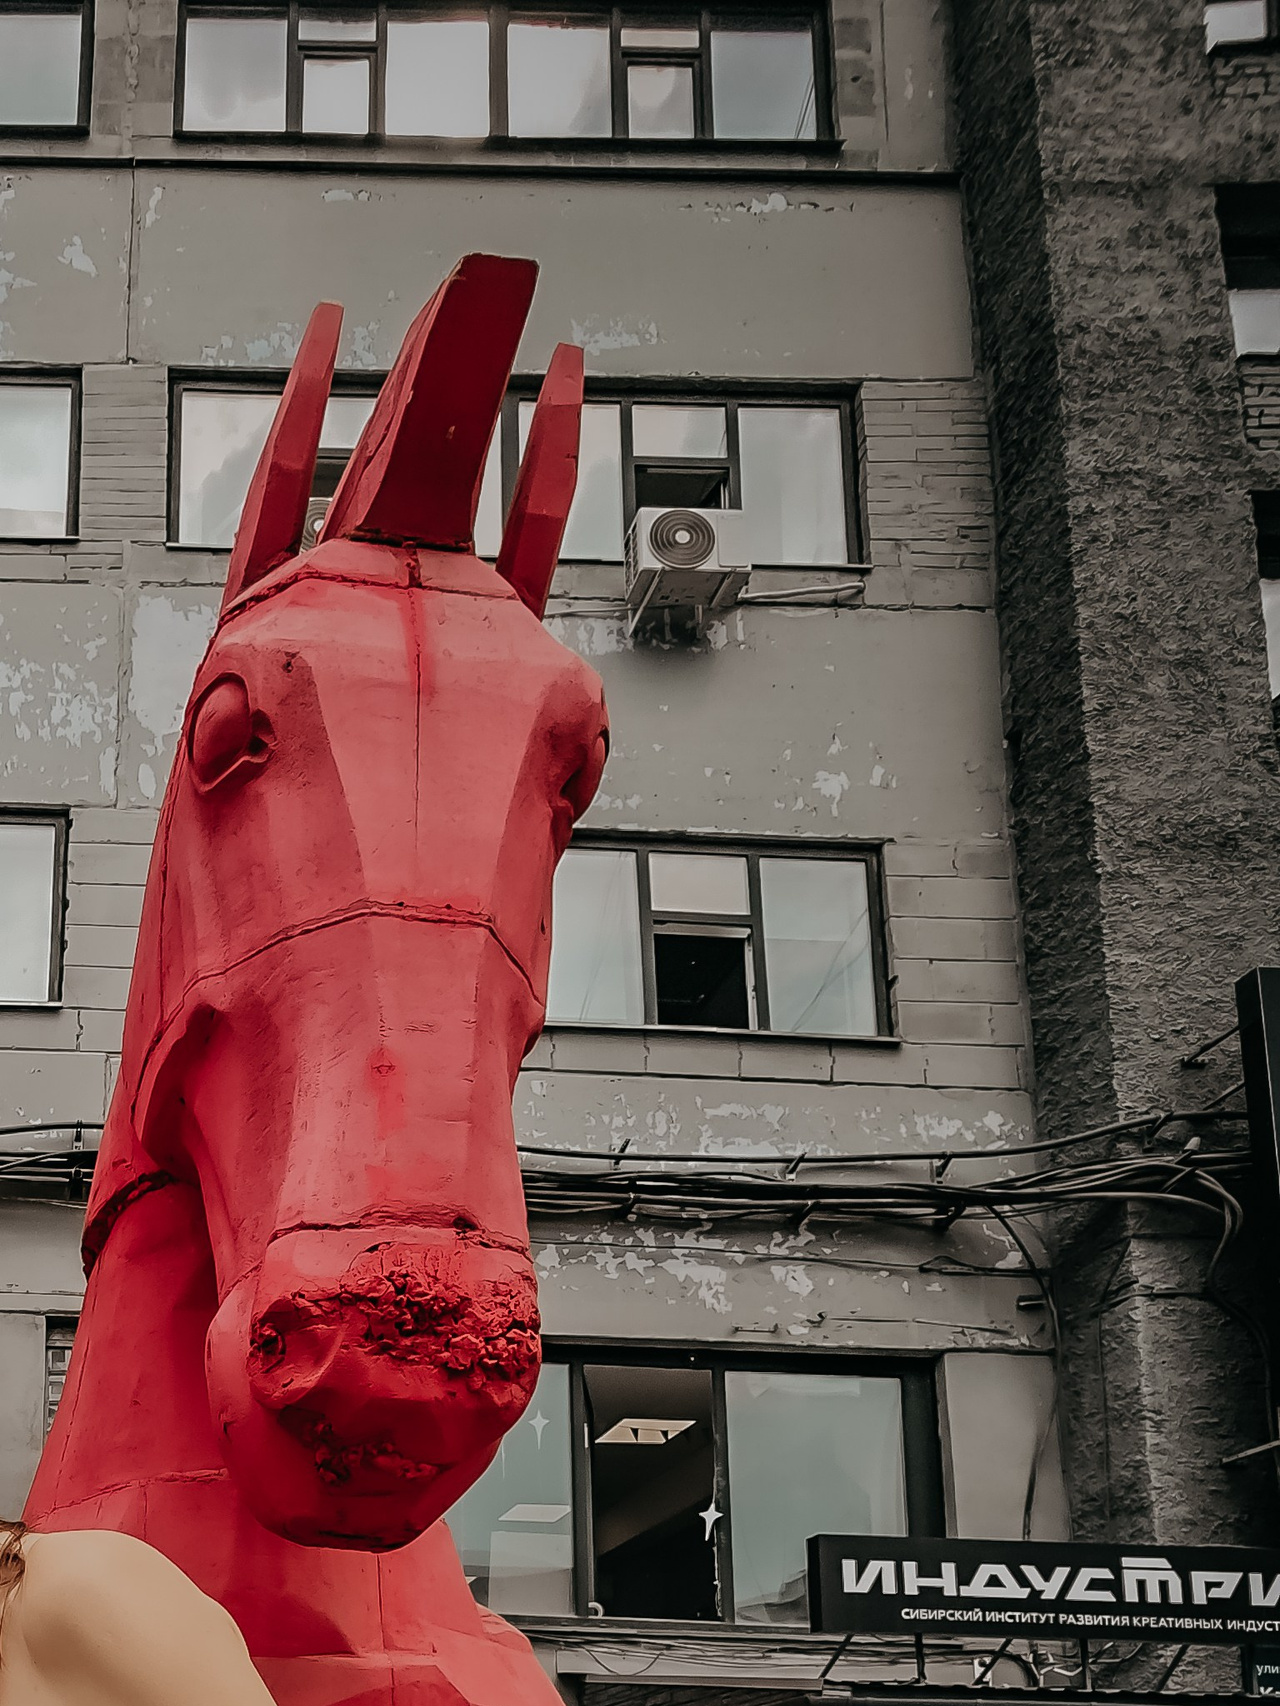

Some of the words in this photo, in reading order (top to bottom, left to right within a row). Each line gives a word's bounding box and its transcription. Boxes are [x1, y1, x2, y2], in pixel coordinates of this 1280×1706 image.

[900, 1607, 983, 1622] СИБИРСКИЙ
[985, 1611, 1056, 1624] ИНСТИТУТ
[1058, 1613, 1130, 1627] РАЗВИТИЯ
[1132, 1616, 1223, 1630] КРЕАТИВНЫХ
[1255, 1664, 1280, 1676] ули
